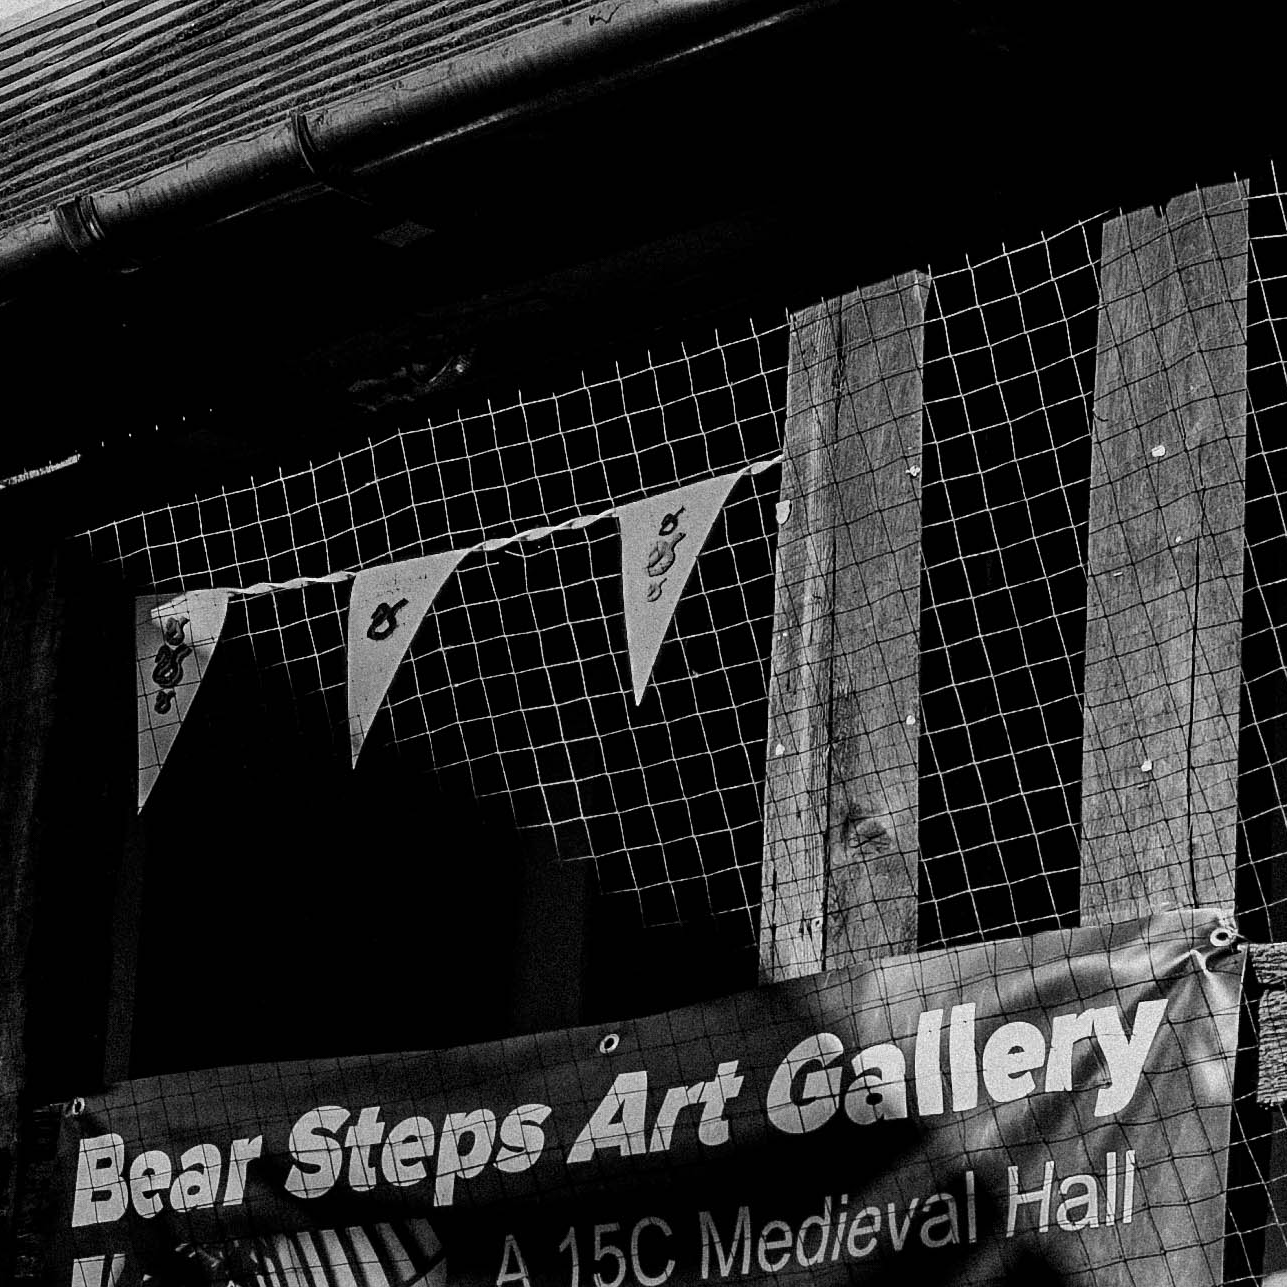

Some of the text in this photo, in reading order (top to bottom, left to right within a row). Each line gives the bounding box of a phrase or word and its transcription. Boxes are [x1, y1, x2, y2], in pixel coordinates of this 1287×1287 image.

[71, 998, 1169, 1229] Bear Steps Art Gallery
[699, 1169, 977, 1280] Medieval
[1007, 1150, 1138, 1237] Hall
